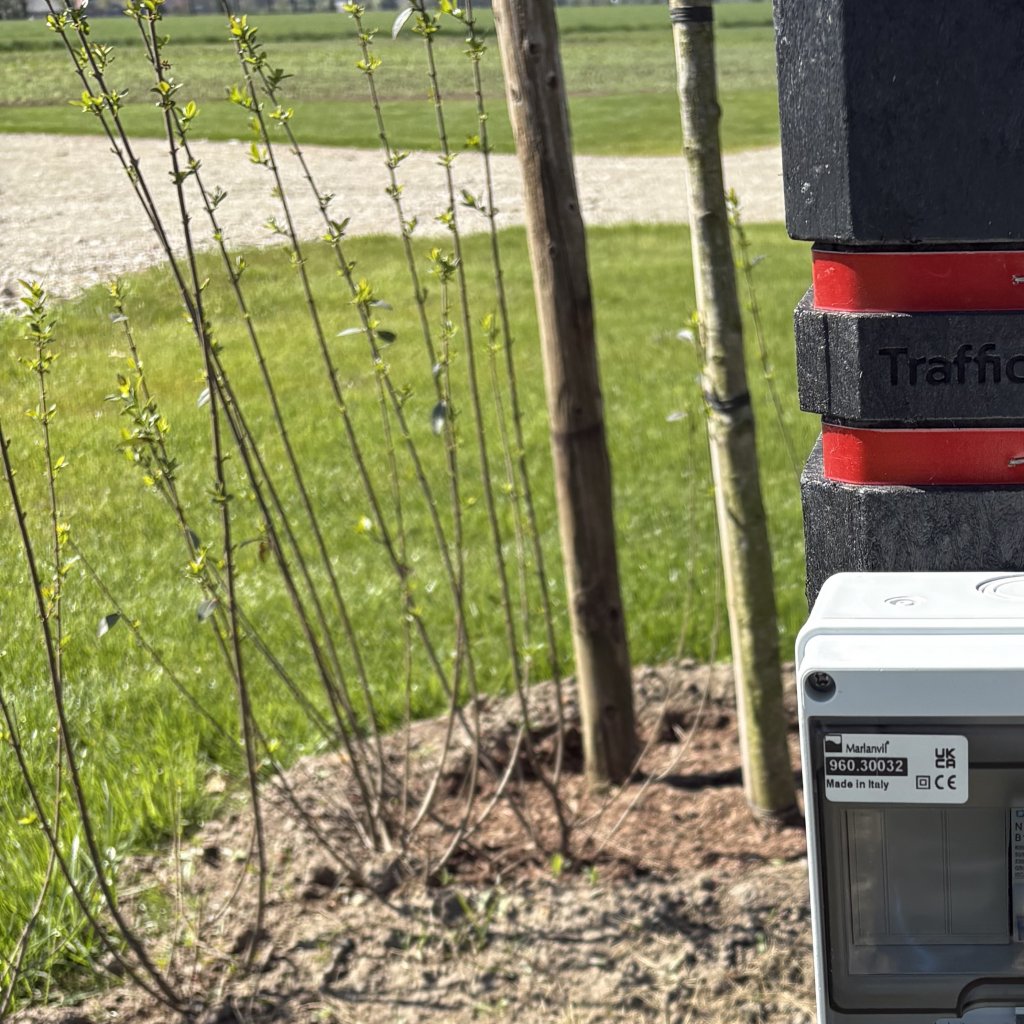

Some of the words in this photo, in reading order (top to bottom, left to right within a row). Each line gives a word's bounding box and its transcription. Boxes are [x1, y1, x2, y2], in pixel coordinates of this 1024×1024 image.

[846, 740, 889, 754] Marlanvil
[829, 759, 904, 773] 960.30032
[826, 779, 852, 789] Made
[856, 779, 865, 789] in
[868, 779, 889, 791] Italy
